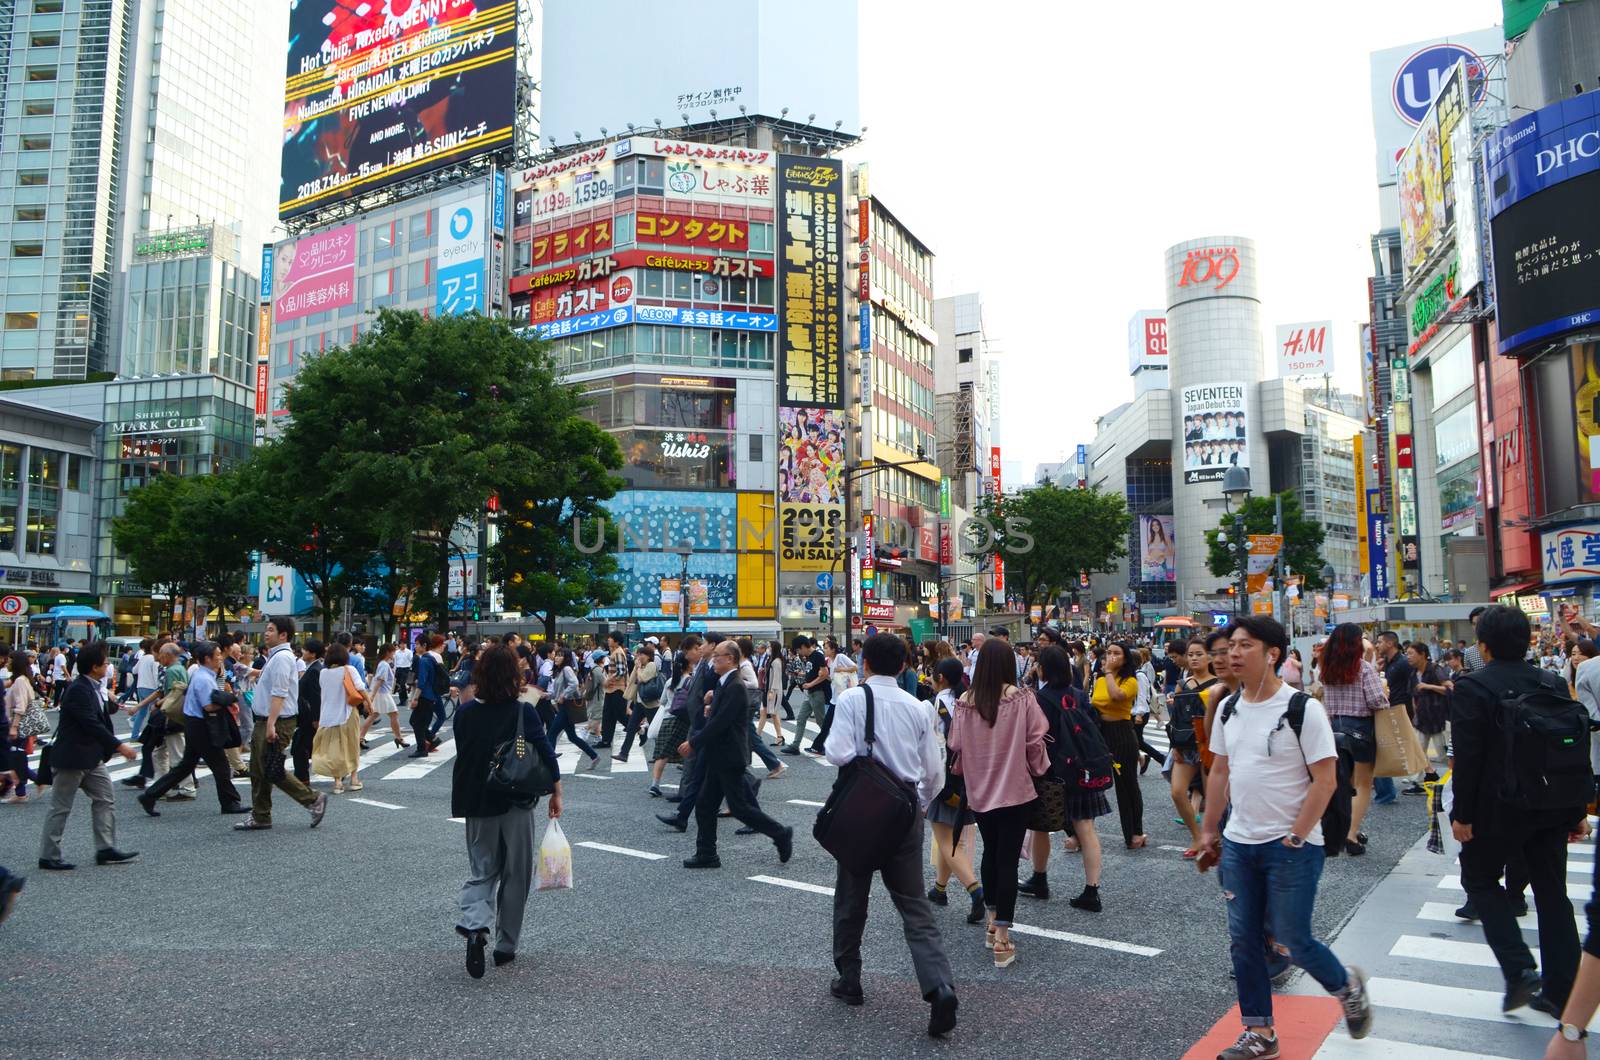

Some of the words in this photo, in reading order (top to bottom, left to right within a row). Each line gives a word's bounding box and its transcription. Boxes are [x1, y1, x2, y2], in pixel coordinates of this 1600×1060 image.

[301, 52, 320, 74] Hot
[398, 27, 496, 80] 水曜日のカンパネラ
[677, 85, 742, 104] デザイン製作中
[349, 102, 371, 122] FIVE
[371, 92, 393, 113] NEW
[370, 129, 385, 144] AND
[385, 121, 406, 137] MORE.
[1502, 121, 1537, 148] Channel
[1535, 130, 1600, 177] DHC
[702, 170, 769, 196] しゃぶ葉
[516, 199, 531, 215] 9F
[636, 215, 745, 245] コンタクト
[814, 192, 825, 260] MOMOIRO
[310, 233, 352, 257] 品川スキン
[443, 238, 479, 259] eyecity
[533, 223, 611, 260] プライス
[1187, 247, 1238, 258] SHIBUYA
[310, 249, 347, 271] クリニック
[577, 256, 618, 281] ガスト
[712, 257, 763, 278] ガスト
[1176, 254, 1241, 291] 109
[286, 280, 350, 314] 品川美容外科
[613, 287, 631, 297] ガスト
[815, 261, 825, 312] CLOVER
[512, 303, 531, 321] 7F
[557, 287, 605, 318] ガスト
[540, 313, 610, 338] 英会話イーオン
[615, 311, 628, 321] 6F
[640, 309, 673, 320] AEON
[681, 310, 776, 329] 英会話イーオン
[815, 313, 825, 322] Z
[1570, 312, 1591, 326] DHC
[815, 324, 826, 356] BEST
[1283, 326, 1326, 358] H&M
[1288, 361, 1314, 371] 150m
[815, 357, 826, 404] ALBUM
[1184, 386, 1243, 404] SEVENTEEN
[1187, 401, 1205, 413] Japan
[1205, 399, 1226, 410] Debut
[1226, 399, 1241, 409] 5.30
[112, 420, 160, 433] MARK
[167, 418, 207, 429] CITY
[135, 410, 180, 420] SHIBUYA
[664, 432, 685, 442] 渋谷
[661, 442, 711, 459] Ushi8
[783, 507, 841, 527] 2018
[782, 527, 841, 549] 5.23
[782, 548, 805, 560] ON
